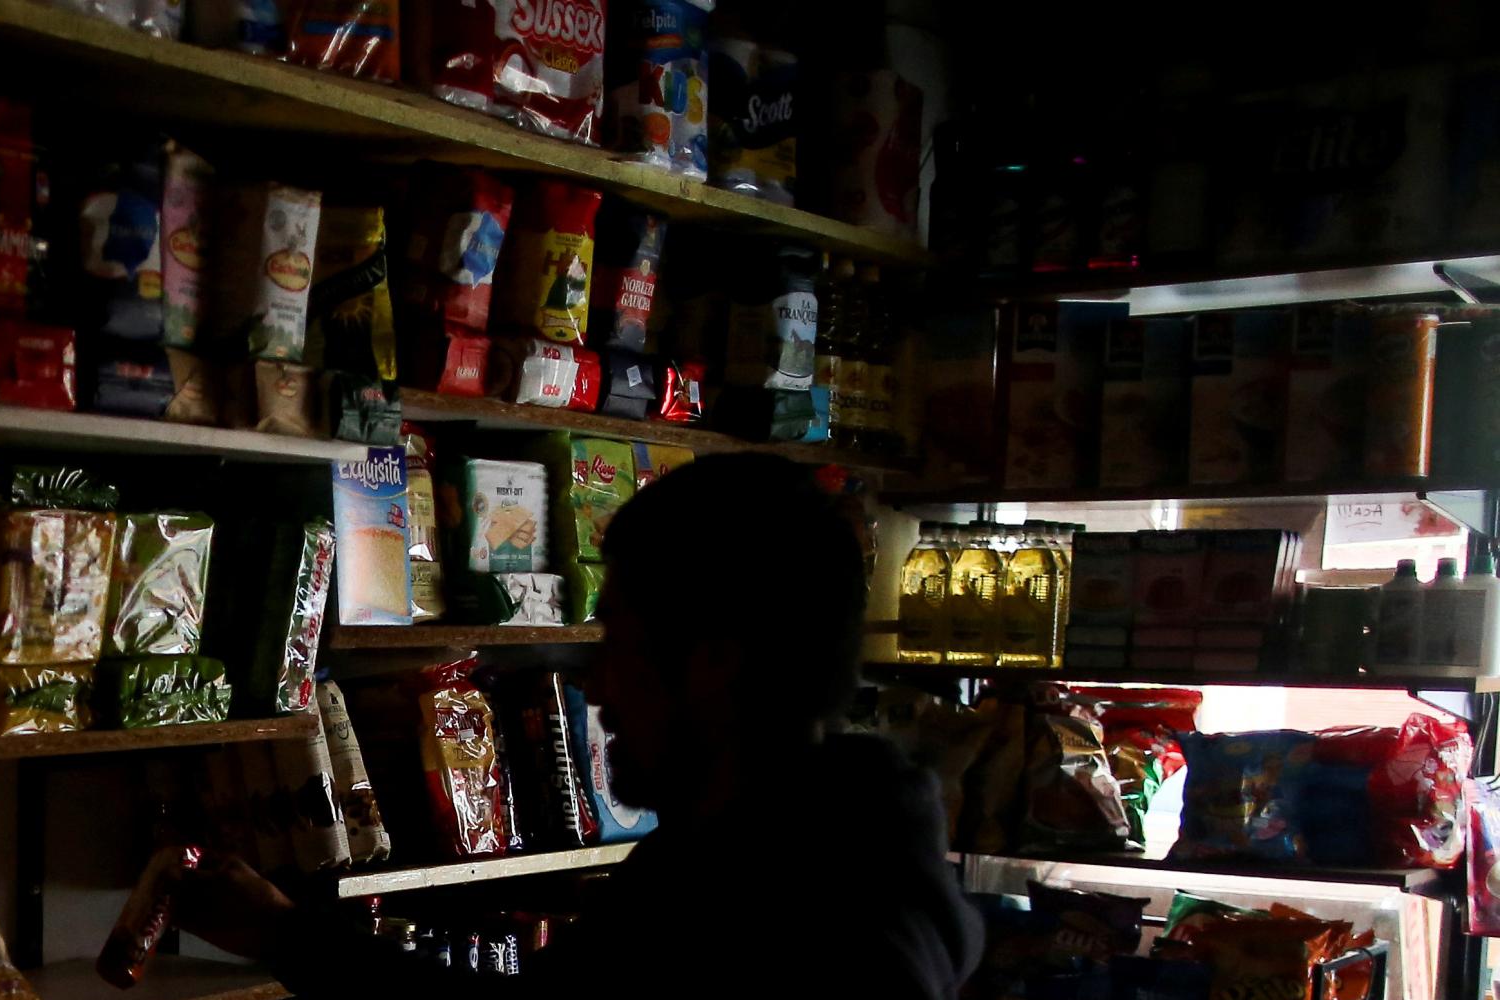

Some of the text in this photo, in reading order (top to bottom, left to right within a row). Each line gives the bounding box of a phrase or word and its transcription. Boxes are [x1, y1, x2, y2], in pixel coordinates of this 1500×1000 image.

[511, 0, 603, 50] Sussex
[747, 91, 795, 134] Scott
[801, 299, 811, 309] LA
[338, 452, 404, 491] Exquisita
